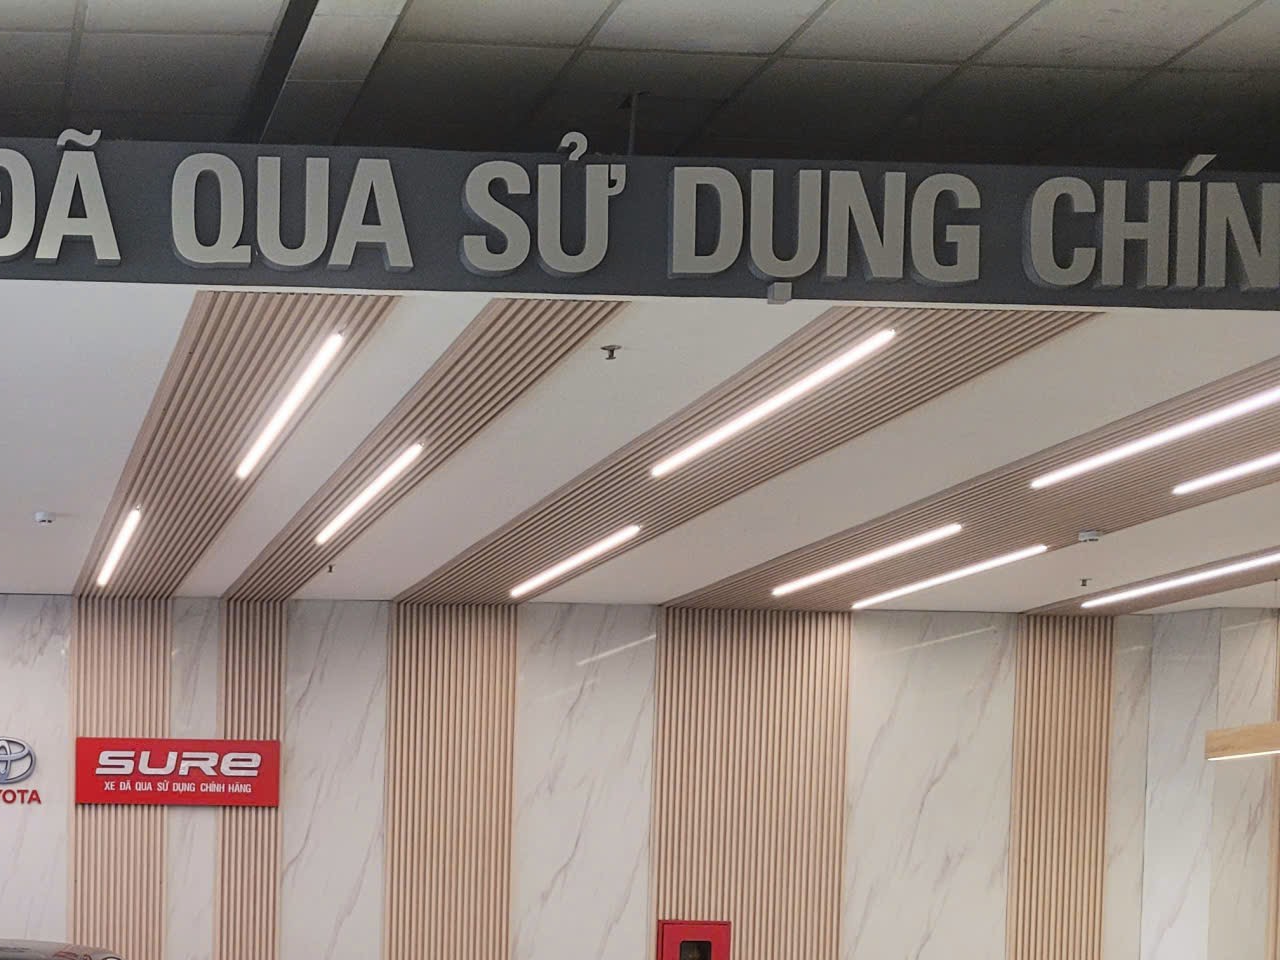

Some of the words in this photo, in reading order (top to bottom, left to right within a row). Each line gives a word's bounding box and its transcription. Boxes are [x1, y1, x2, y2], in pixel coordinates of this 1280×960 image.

[170, 151, 415, 272] QUA
[459, 131, 626, 277] SỬ
[665, 164, 982, 304] DỤNG
[104, 781, 116, 791] XE
[119, 779, 132, 791] ĐÃ
[135, 781, 153, 792] QUA
[157, 779, 169, 792] SỬ
[172, 782, 196, 794] DỤNG
[200, 781, 225, 793] CHÍNH
